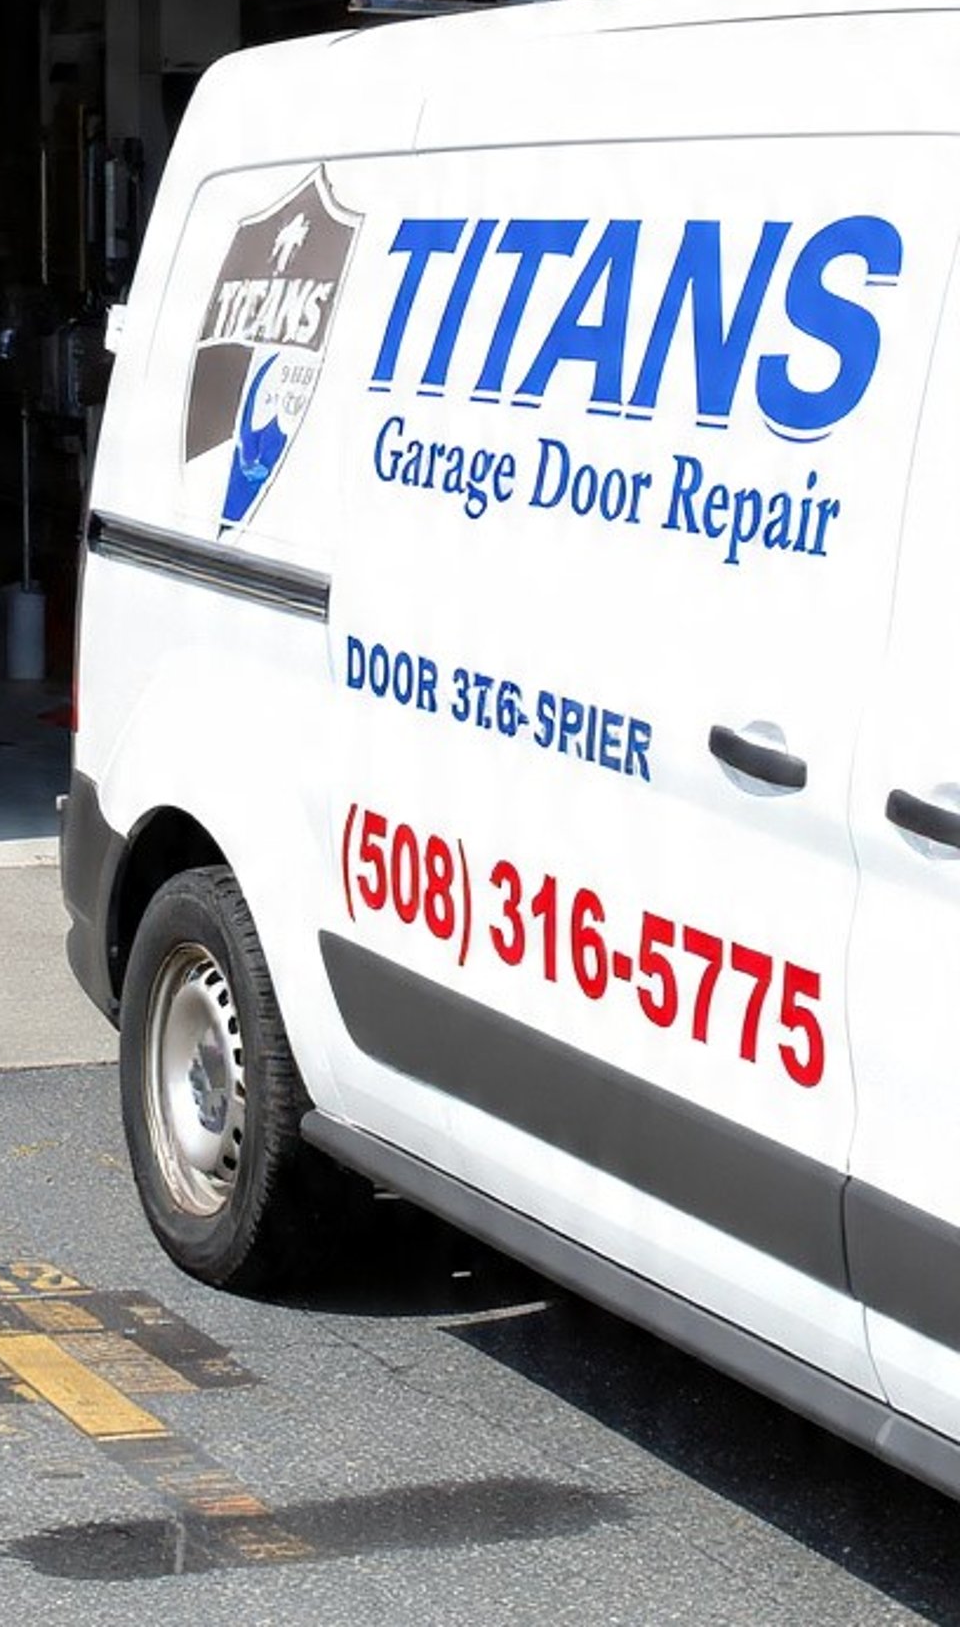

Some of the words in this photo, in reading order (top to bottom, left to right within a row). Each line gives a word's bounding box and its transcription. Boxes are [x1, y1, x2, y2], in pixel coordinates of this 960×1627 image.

[212, 277, 334, 345] TITANS
[370, 215, 902, 441] TITANS
[374, 417, 515, 519] Garage
[529, 438, 651, 525] Door
[664, 455, 841, 566] Repair
[346, 634, 438, 713] DOOR
[342, 803, 471, 967] (508)
[489, 860, 826, 1089] 316-5775
